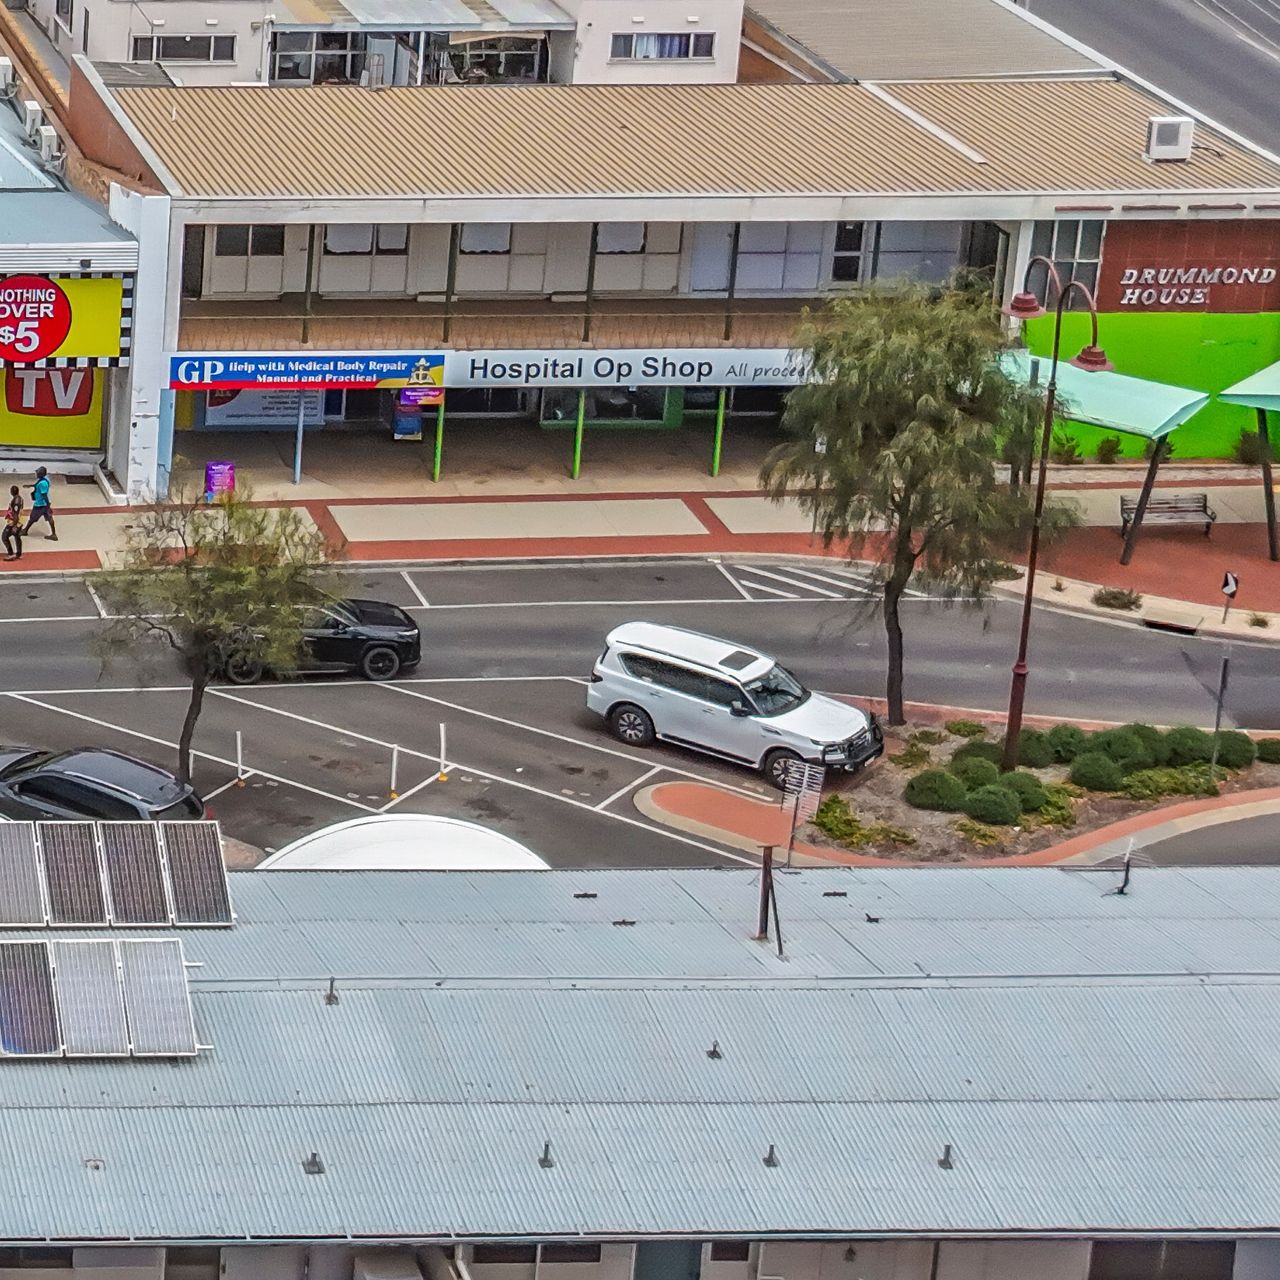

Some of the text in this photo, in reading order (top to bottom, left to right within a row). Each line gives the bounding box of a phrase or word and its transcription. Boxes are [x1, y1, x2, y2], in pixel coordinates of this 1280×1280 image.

[1119, 267, 1278, 285] DRUMMOND
[1120, 288, 1209, 305] HOUSE
[177, 360, 408, 384] GP Help with Medical Body Repair
[256, 373, 377, 383] Manual and Practical
[469, 357, 583, 385] Hospital
[593, 357, 633, 383] Op
[640, 356, 713, 380] Shop
[724, 363, 747, 377] All
[14, 370, 86, 410] TV
